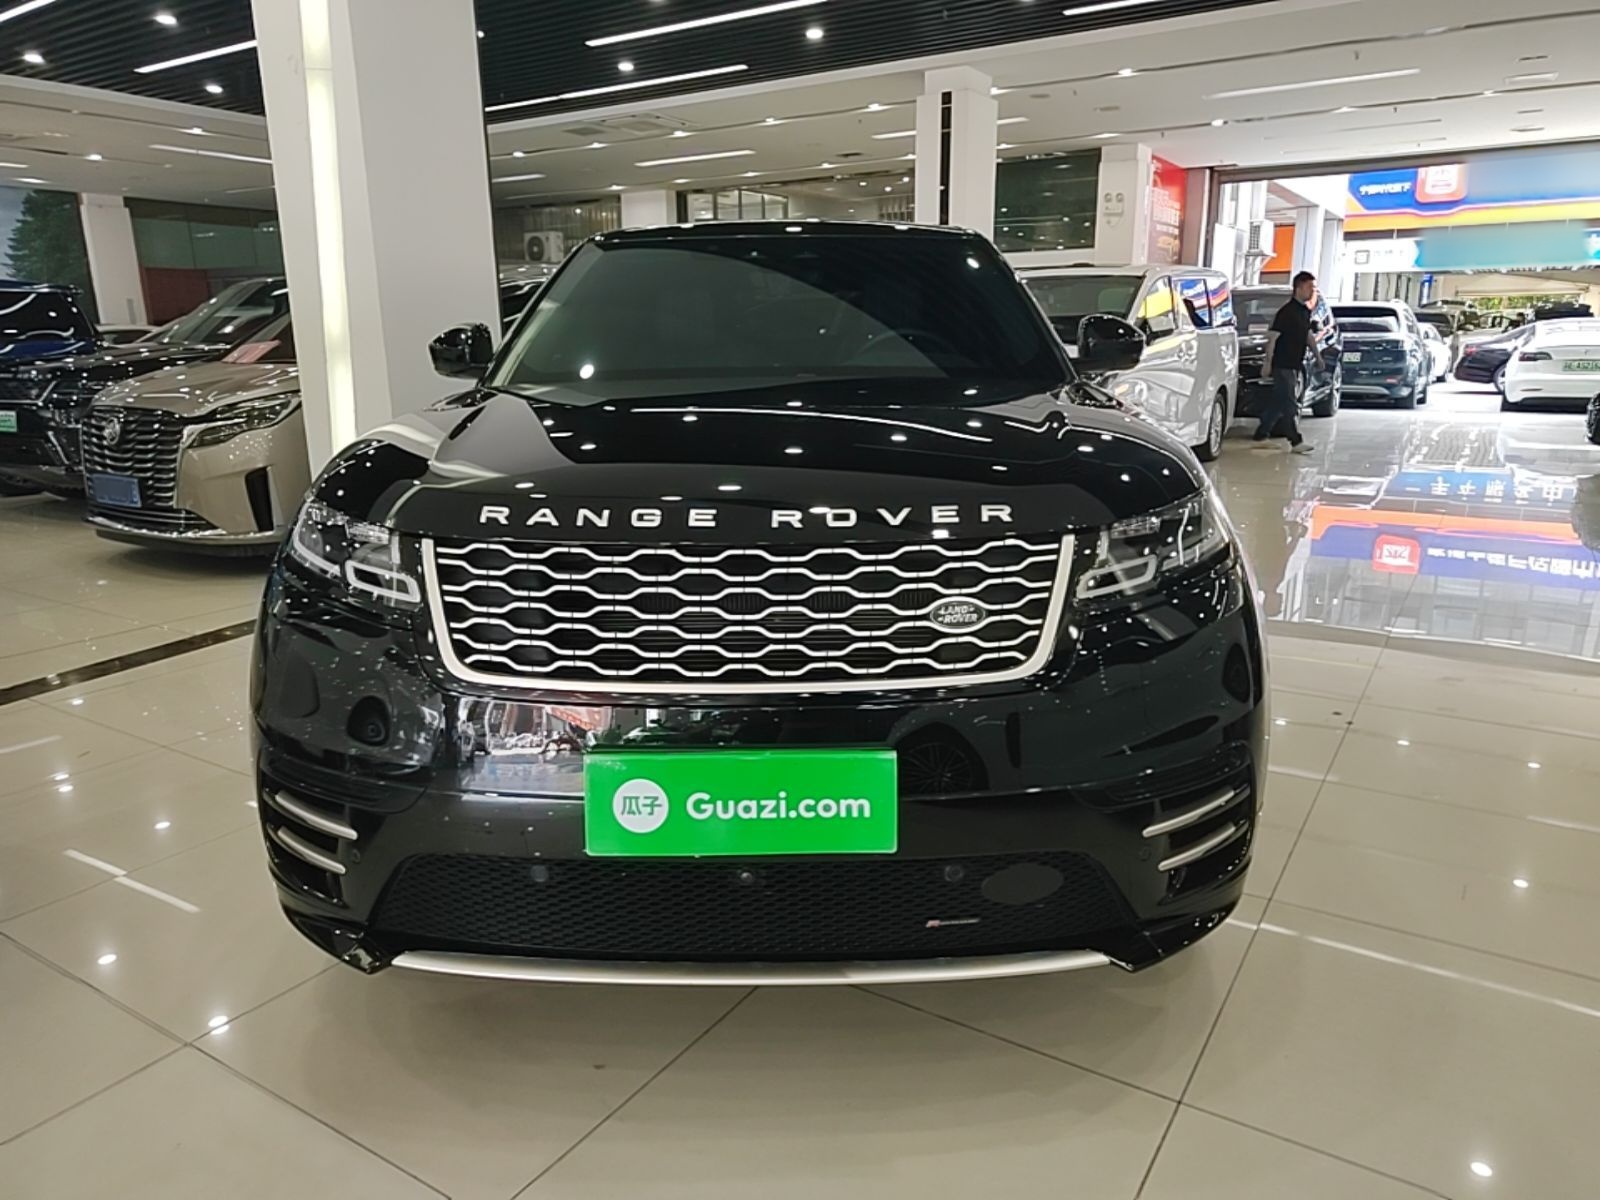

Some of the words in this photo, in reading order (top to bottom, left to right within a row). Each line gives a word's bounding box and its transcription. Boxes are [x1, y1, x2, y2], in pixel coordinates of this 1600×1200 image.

[479, 505, 717, 527] RANGE
[771, 504, 1013, 528] ROVER
[940, 605, 969, 614] LAND
[943, 613, 978, 624] ROVER
[621, 795, 662, 816] 瓜子
[686, 791, 871, 820] Guazi.com
